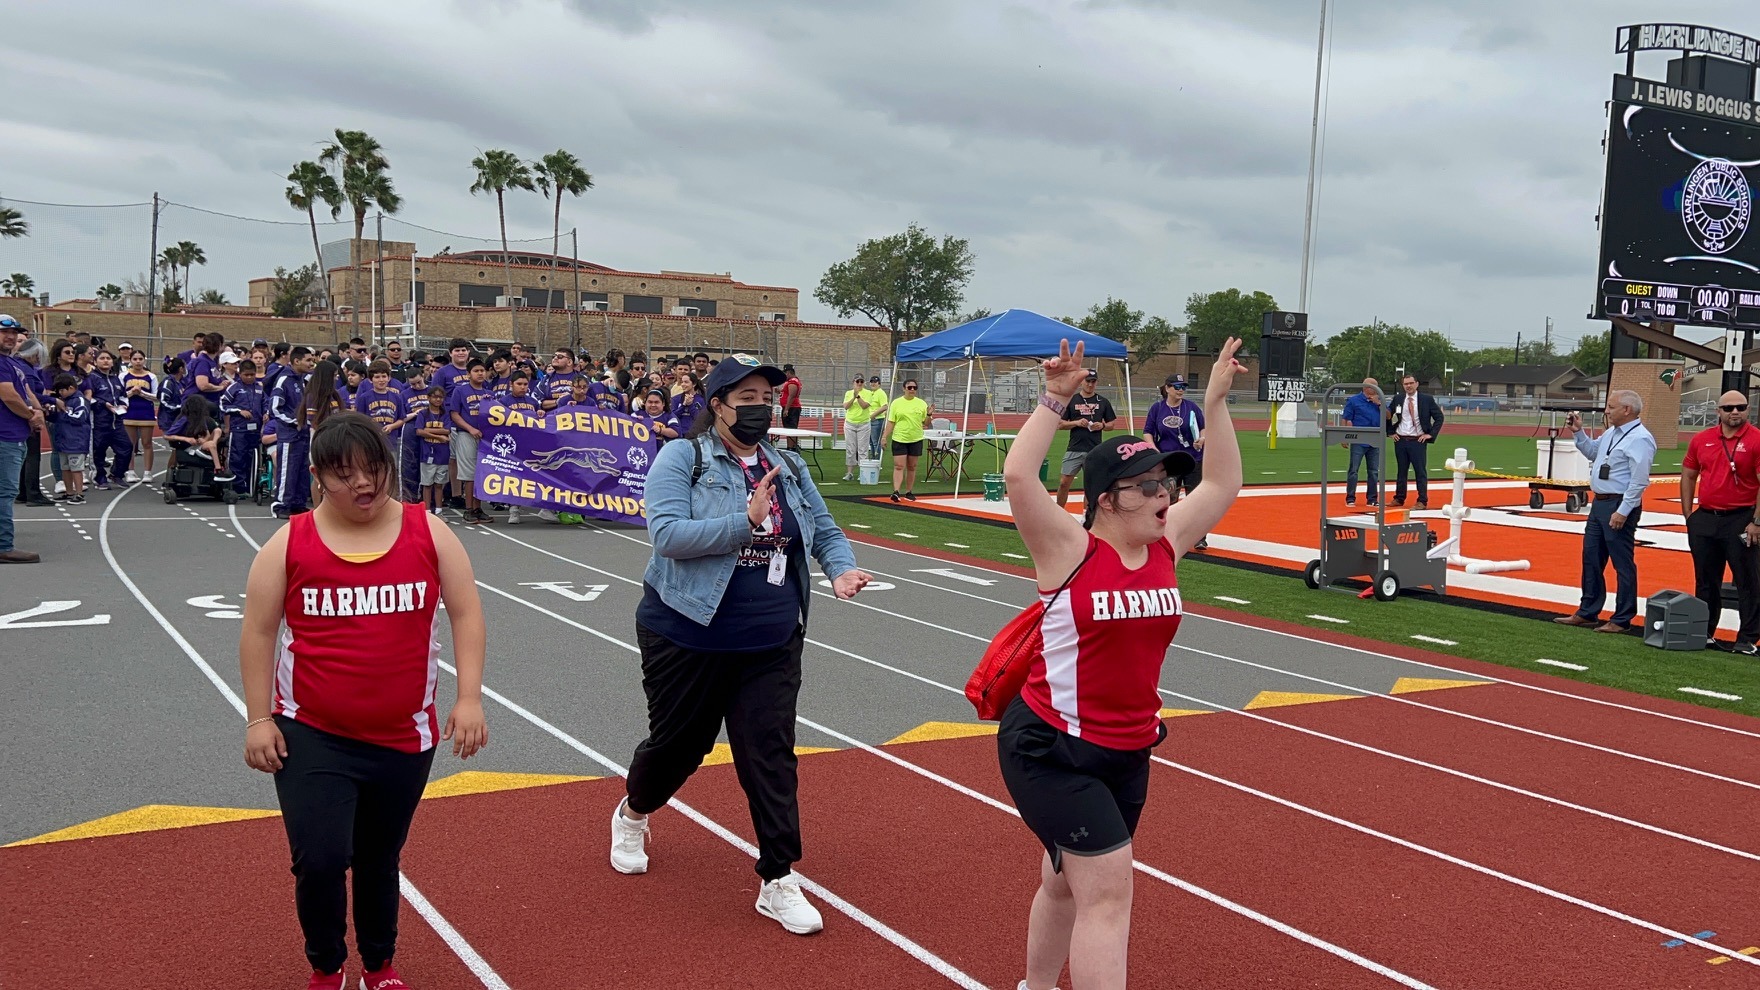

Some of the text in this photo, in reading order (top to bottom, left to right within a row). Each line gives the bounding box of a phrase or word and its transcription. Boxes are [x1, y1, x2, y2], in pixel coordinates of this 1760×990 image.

[1638, 25, 1756, 62] HARLINGEN
[1631, 81, 1643, 100] J.
[1648, 84, 1692, 110] LEWIS
[1696, 93, 1751, 120] BOGGUS
[1684, 161, 1749, 230] HARLINGEN PUBLIC SCHOOLS
[1626, 284, 1652, 296] GUEST
[1657, 286, 1678, 299] DOWN
[1698, 289, 1729, 307] 00.00
[1739, 293, 1753, 306] BALL
[1621, 299, 1628, 315] 0
[1657, 303, 1676, 316] TO GO
[1268, 380, 1305, 391] WE ARE
[1267, 389, 1305, 402] HCISD
[488, 405, 650, 442] SAN BENITO
[481, 459, 523, 471] Olympics
[486, 454, 520, 466] Special
[622, 470, 647, 480] Specia
[629, 487, 643, 495] Texas
[1396, 531, 1420, 544] GILL
[302, 581, 427, 617] HARMONY
[1091, 587, 1182, 621] HARMON
